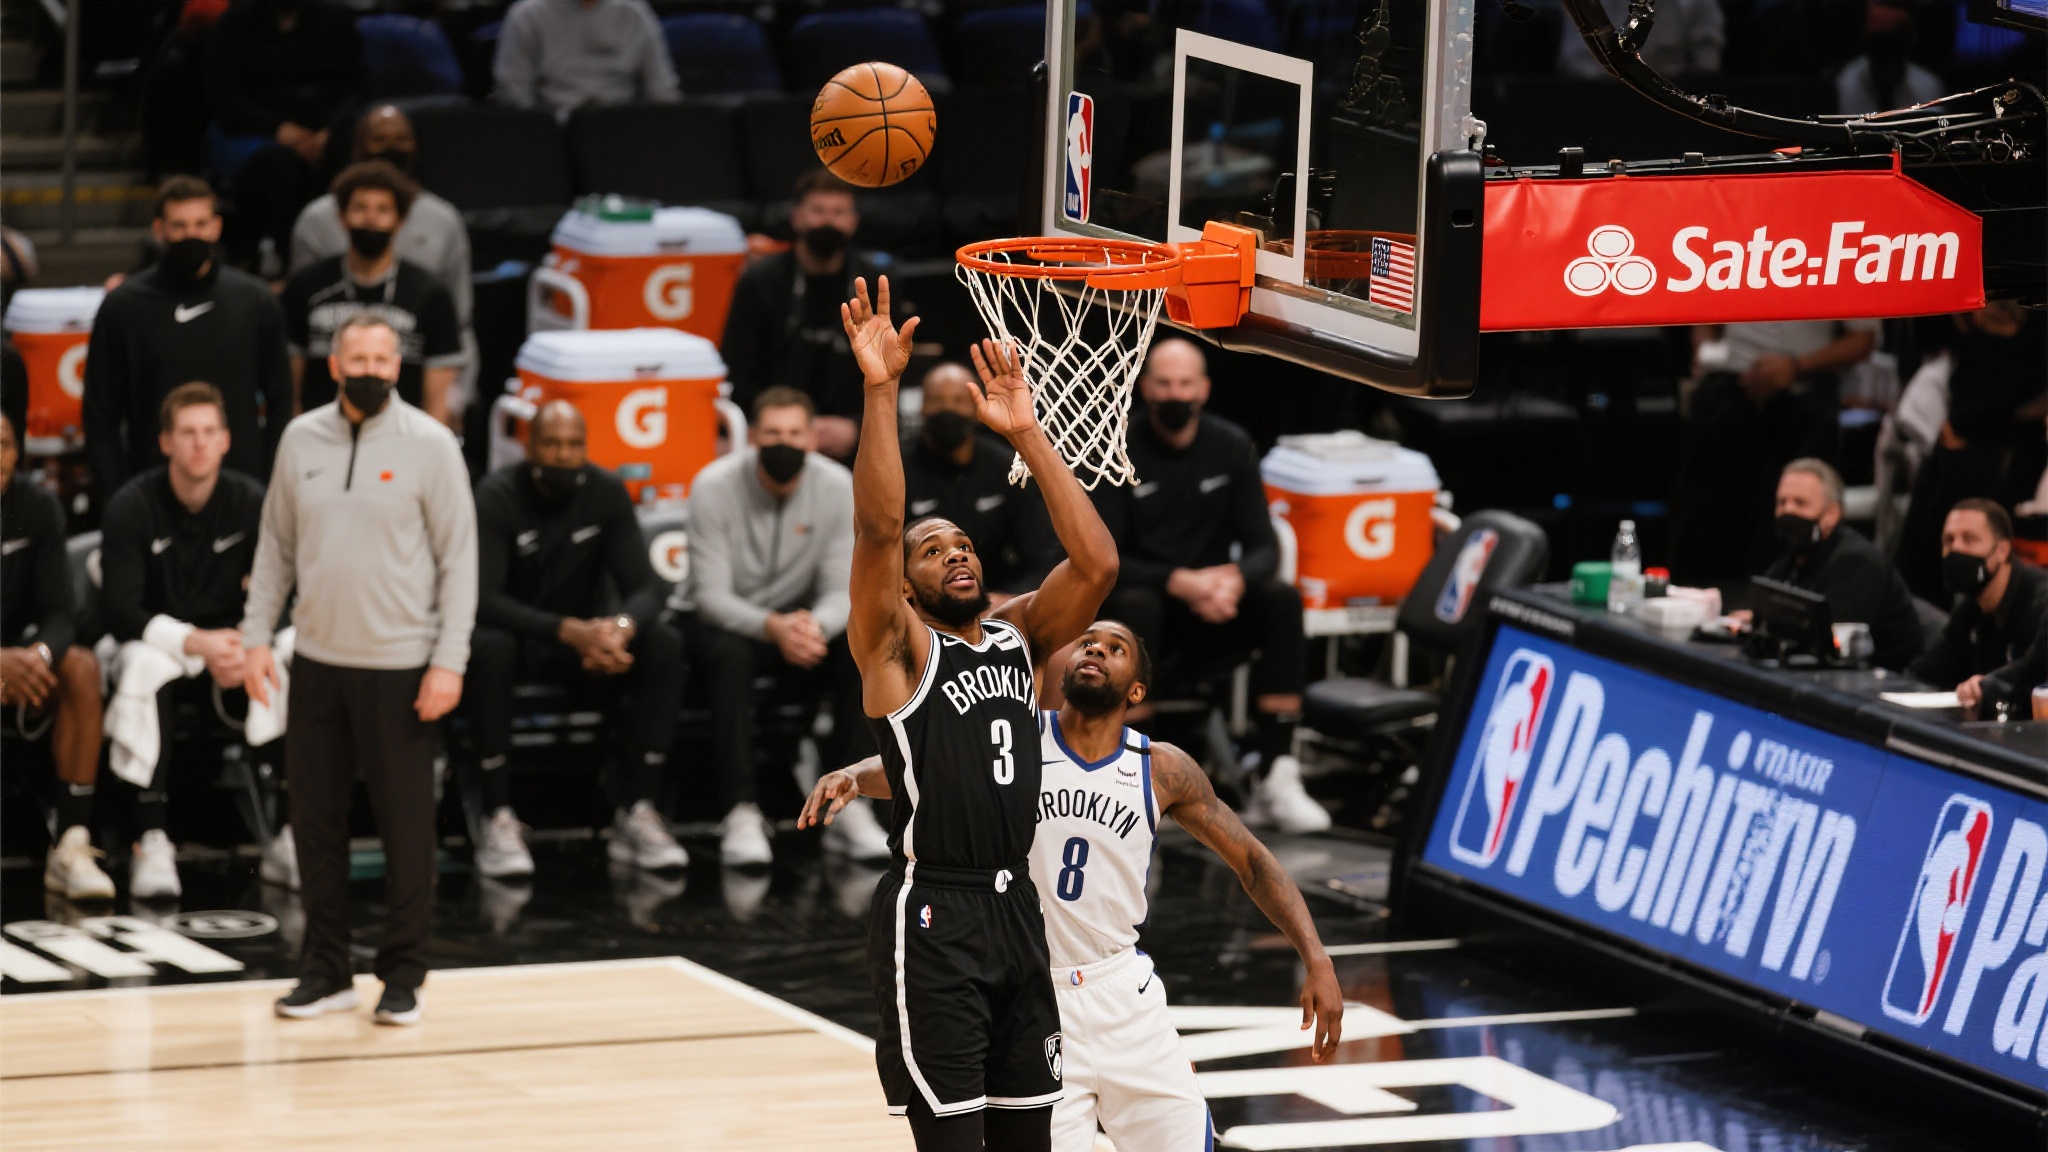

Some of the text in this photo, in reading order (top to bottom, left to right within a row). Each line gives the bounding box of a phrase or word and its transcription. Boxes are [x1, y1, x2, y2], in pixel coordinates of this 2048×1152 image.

[644, 265, 693, 320] G
[615, 387, 668, 449] G
[1344, 499, 1397, 560] G
[990, 718, 1015, 786] 3
[1056, 836, 1090, 902] 8
